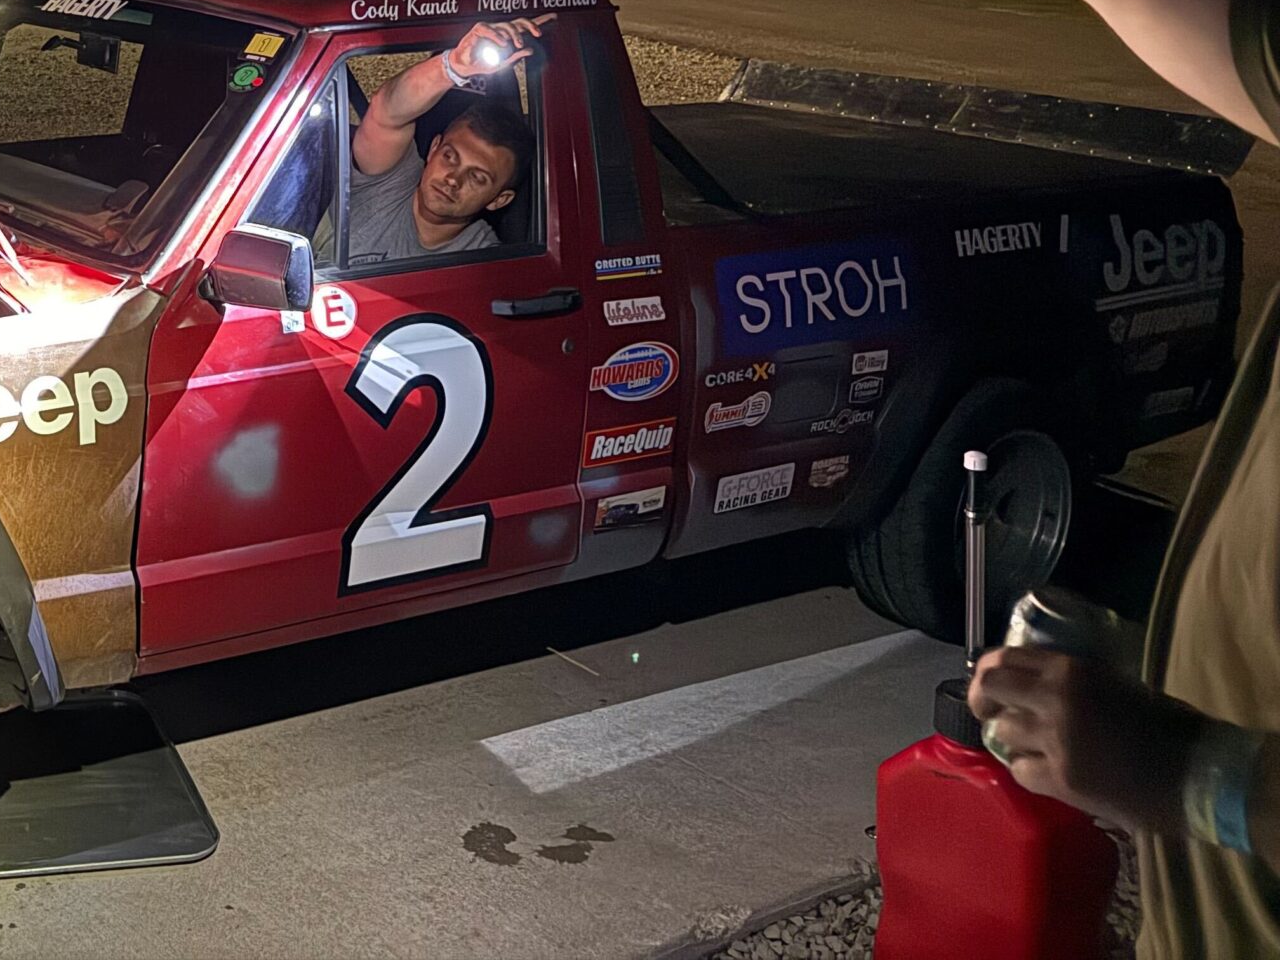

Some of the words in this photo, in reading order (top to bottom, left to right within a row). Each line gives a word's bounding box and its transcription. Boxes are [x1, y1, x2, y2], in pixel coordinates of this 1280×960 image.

[351, 0, 399, 21] Cody
[954, 220, 1042, 258] HAGERTY
[1103, 213, 1227, 293] Jeep
[595, 256, 633, 271] CRESTED
[635, 253, 661, 267] BUTTE
[322, 294, 346, 327] E
[735, 255, 908, 334] STROH
[591, 359, 664, 390] HOWARDS
[705, 361, 776, 388] CORE4X4
[339, 314, 494, 597] 2
[590, 424, 674, 460] RaceQuip
[717, 493, 756, 512] RACING
[760, 486, 789, 501] GEAR
[721, 469, 790, 497] G-FORCE
